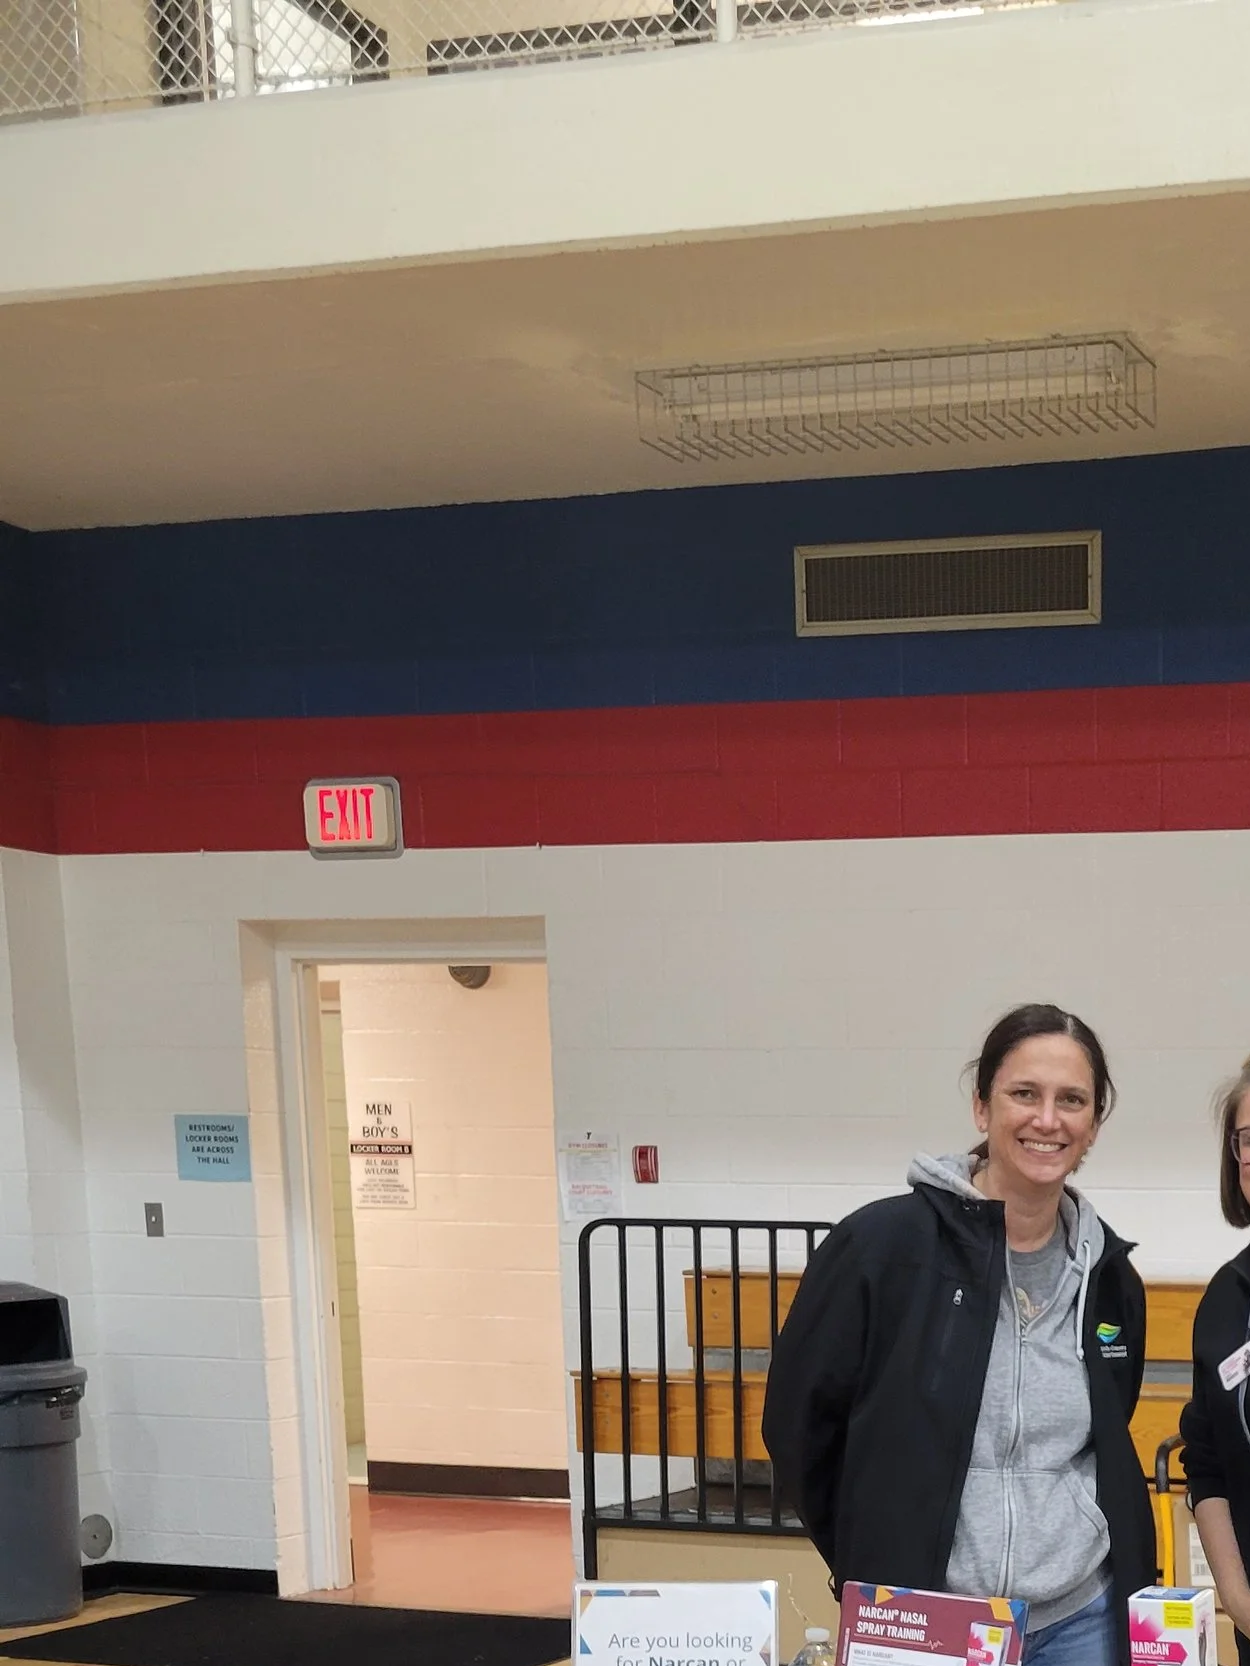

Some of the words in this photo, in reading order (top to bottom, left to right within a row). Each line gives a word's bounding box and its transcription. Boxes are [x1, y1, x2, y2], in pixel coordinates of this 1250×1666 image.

[319, 788, 374, 841] EXIT
[366, 1104, 392, 1115] MEN
[189, 1124, 234, 1132] RESTROOMS/
[362, 1126, 399, 1138] BOY'S
[213, 1135, 238, 1143] ROOMS
[207, 1146, 234, 1154] ACROSS
[353, 1145, 380, 1153] LOCKER
[197, 1156, 210, 1164] THE
[212, 1157, 230, 1165] HALL
[900, 1610, 929, 1626] NASAL
[856, 1621, 886, 1636] SPRAY
[886, 1625, 926, 1642] TRAINING
[608, 1633, 640, 1648] Are
[645, 1636, 679, 1653] you
[686, 1632, 752, 1652] looking
[1131, 1640, 1169, 1656] NARCAN
